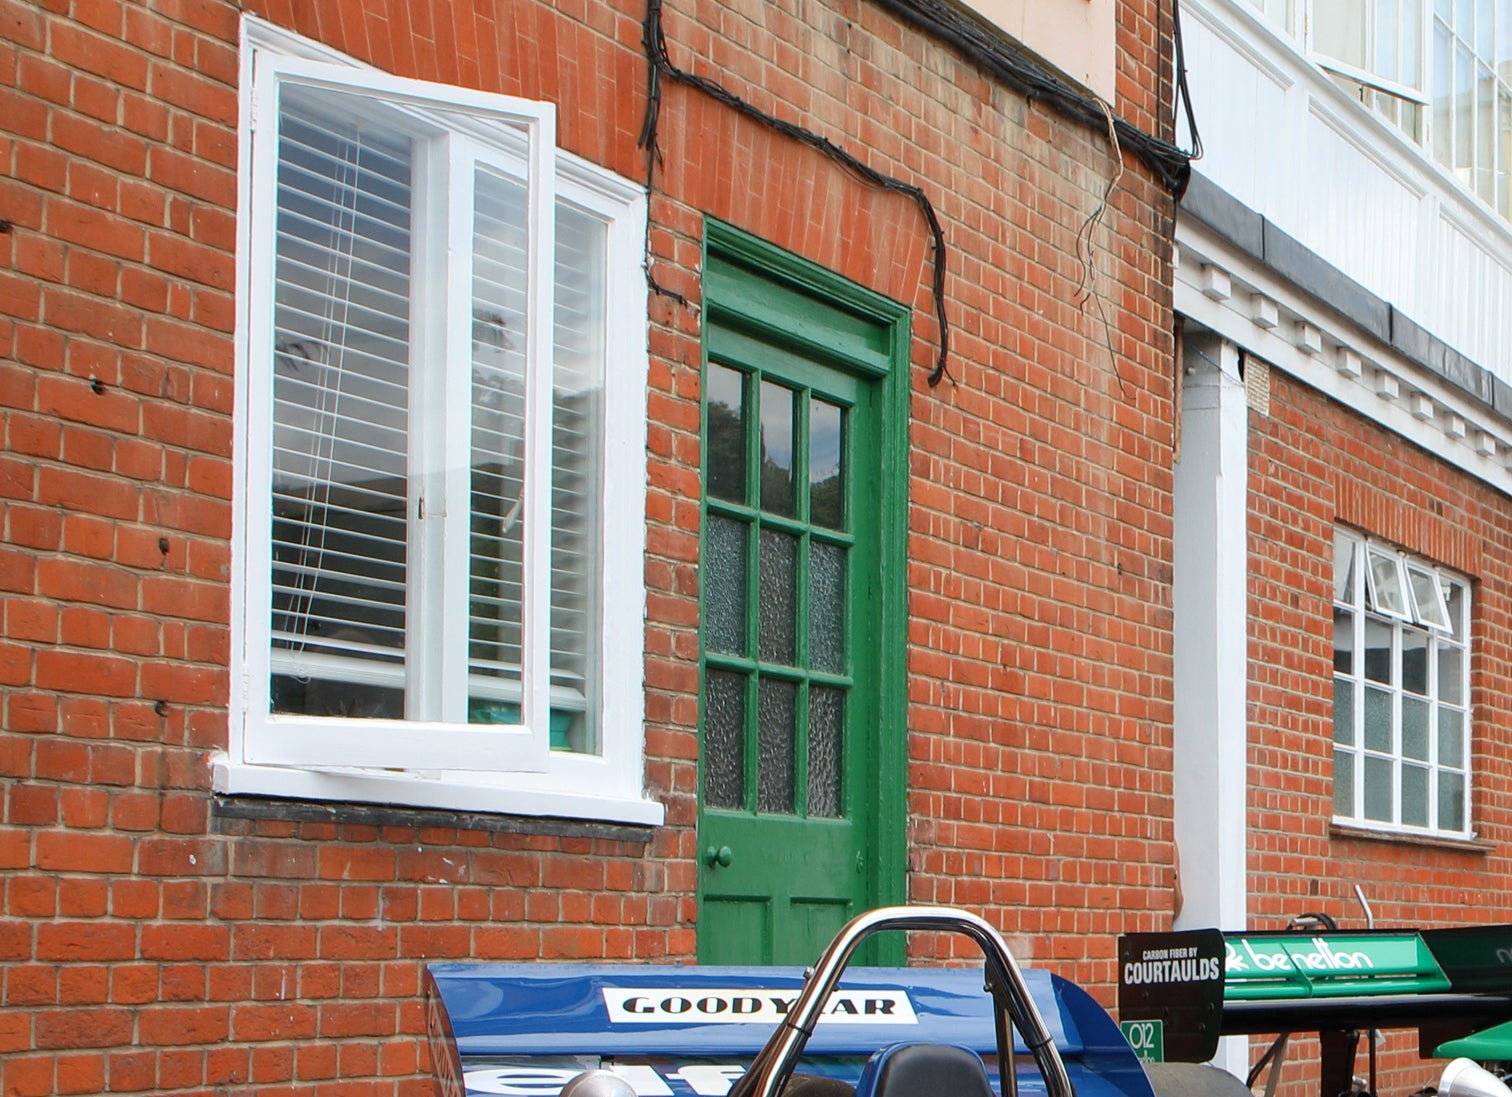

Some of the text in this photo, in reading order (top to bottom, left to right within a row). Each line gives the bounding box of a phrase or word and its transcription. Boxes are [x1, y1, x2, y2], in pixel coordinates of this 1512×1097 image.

[1142, 949, 1169, 961] CARBON
[1188, 947, 1198, 958] BY
[1241, 937, 1374, 971] benetton
[1124, 957, 1220, 985] COURTAULDS
[622, 996, 897, 1015] GOODYAR
[463, 1065, 747, 1096] elf
